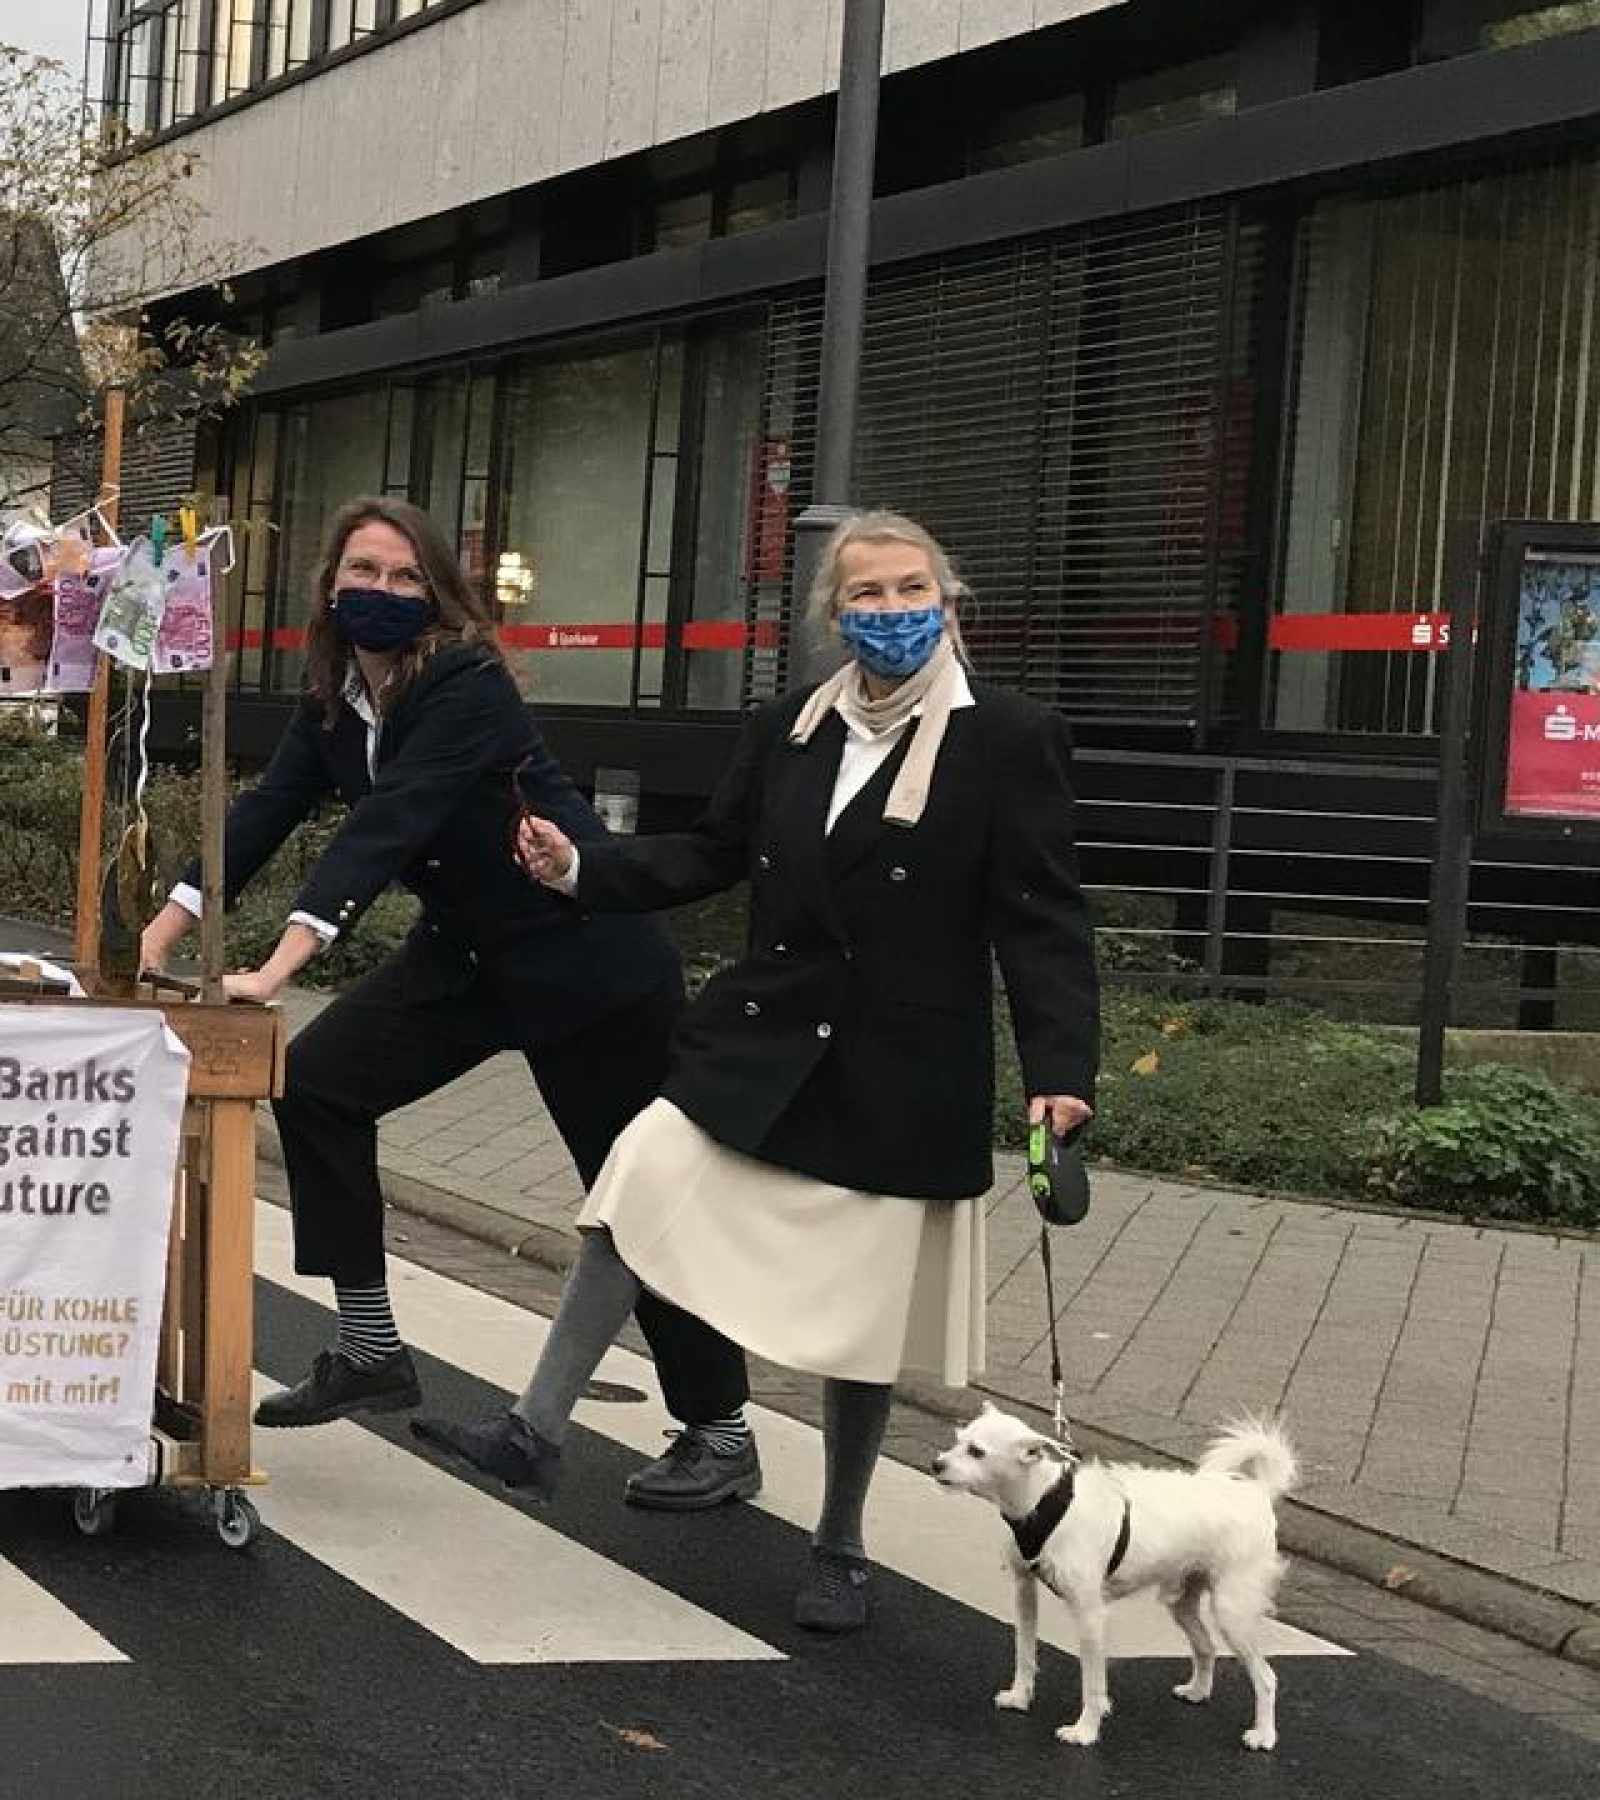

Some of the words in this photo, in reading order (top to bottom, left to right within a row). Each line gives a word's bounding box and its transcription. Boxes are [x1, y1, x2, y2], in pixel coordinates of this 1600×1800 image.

[53, 1296, 139, 1323] KOHLE
[6, 1374, 53, 1403] mit
[63, 1373, 122, 1404] mir!
